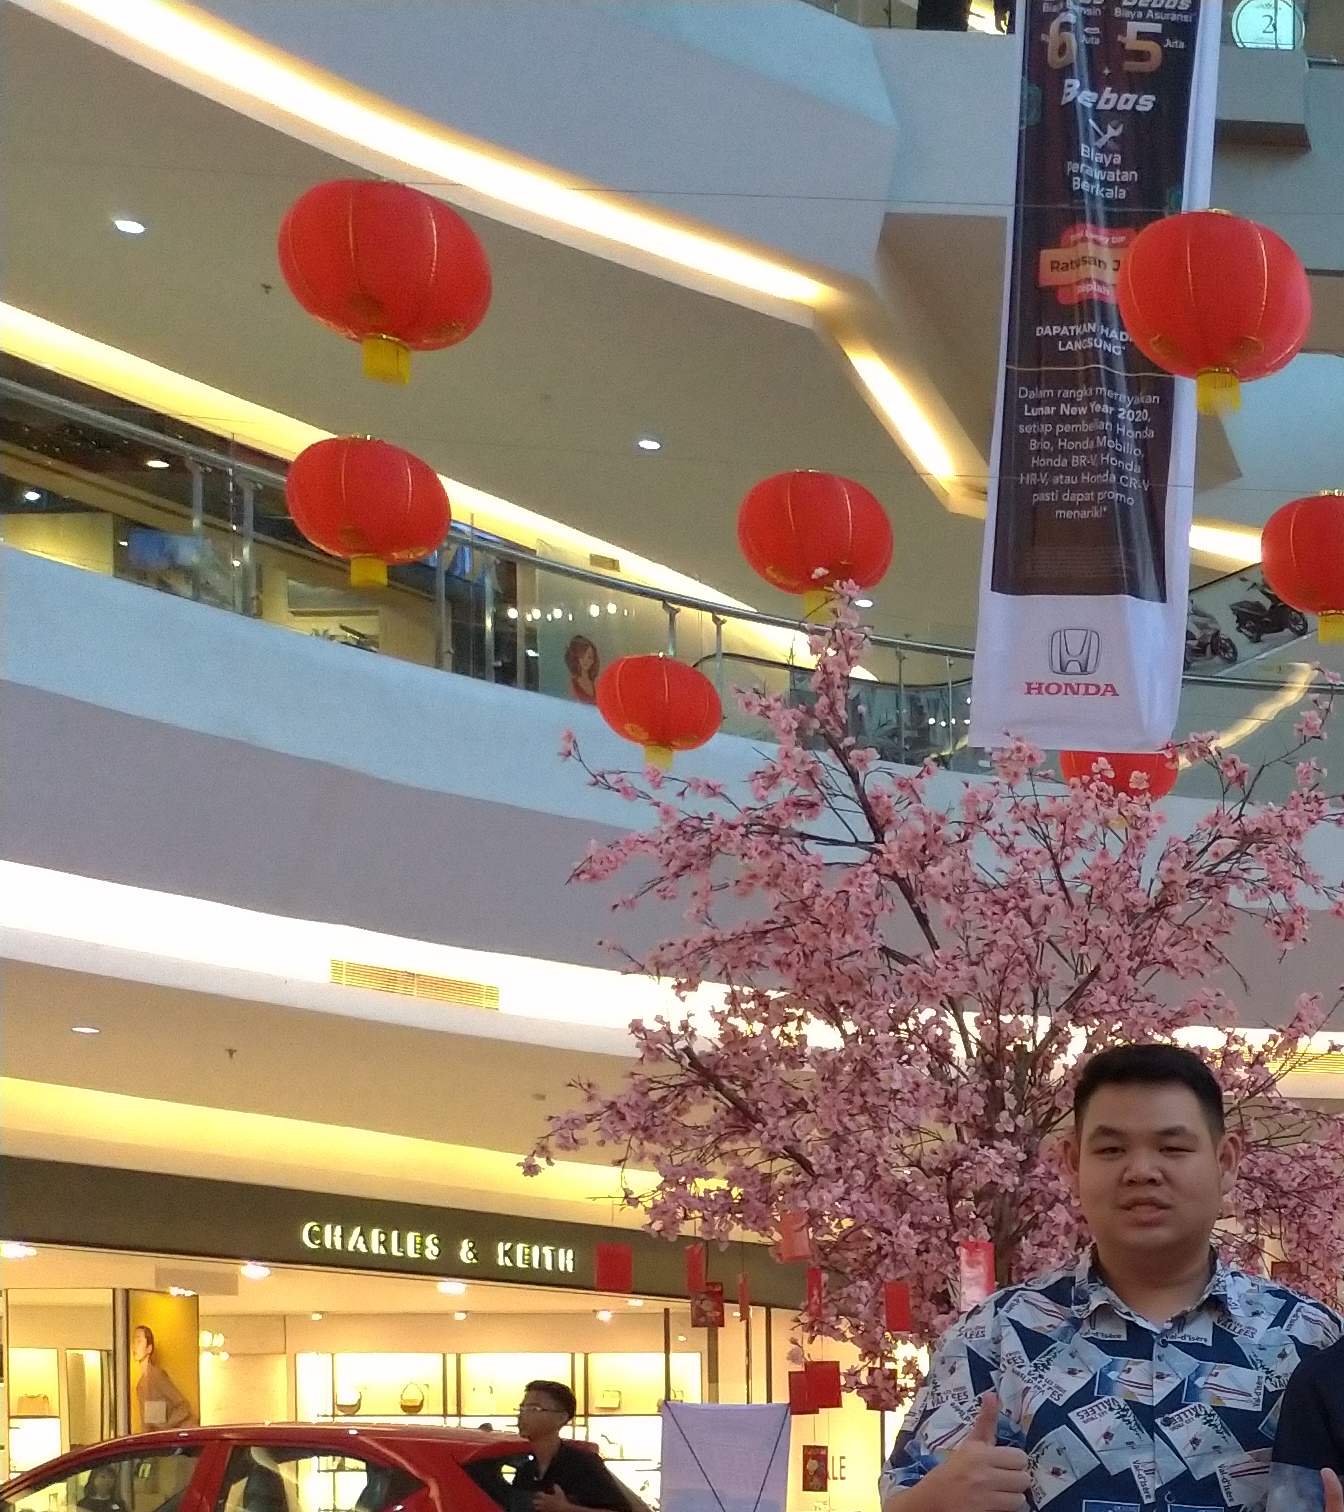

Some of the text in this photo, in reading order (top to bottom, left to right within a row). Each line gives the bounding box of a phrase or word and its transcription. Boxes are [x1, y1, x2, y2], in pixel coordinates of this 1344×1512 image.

[1122, 21, 1185, 72] 5 Juta
[1062, 79, 1156, 112] Bebas
[1080, 143, 1121, 166] Biaya
[1072, 176, 1126, 199] Berkala
[1019, 387, 1053, 398] Dalam
[1024, 405, 1056, 416] Lunar
[1060, 404, 1087, 416] New
[1090, 402, 1114, 414] Year
[1019, 423, 1155, 439] setiap Honda
[1031, 454, 1141, 474] Honda Honda
[1019, 473, 1049, 485] HR-V,
[1052, 473, 1078, 484] atau
[1120, 475, 1150, 492] CR-V
[1032, 491, 1059, 504] pasti
[1063, 490, 1094, 506] dapat
[1024, 681, 1120, 698] HONDA
[301, 1221, 576, 1274] CHARLES & KEITH
